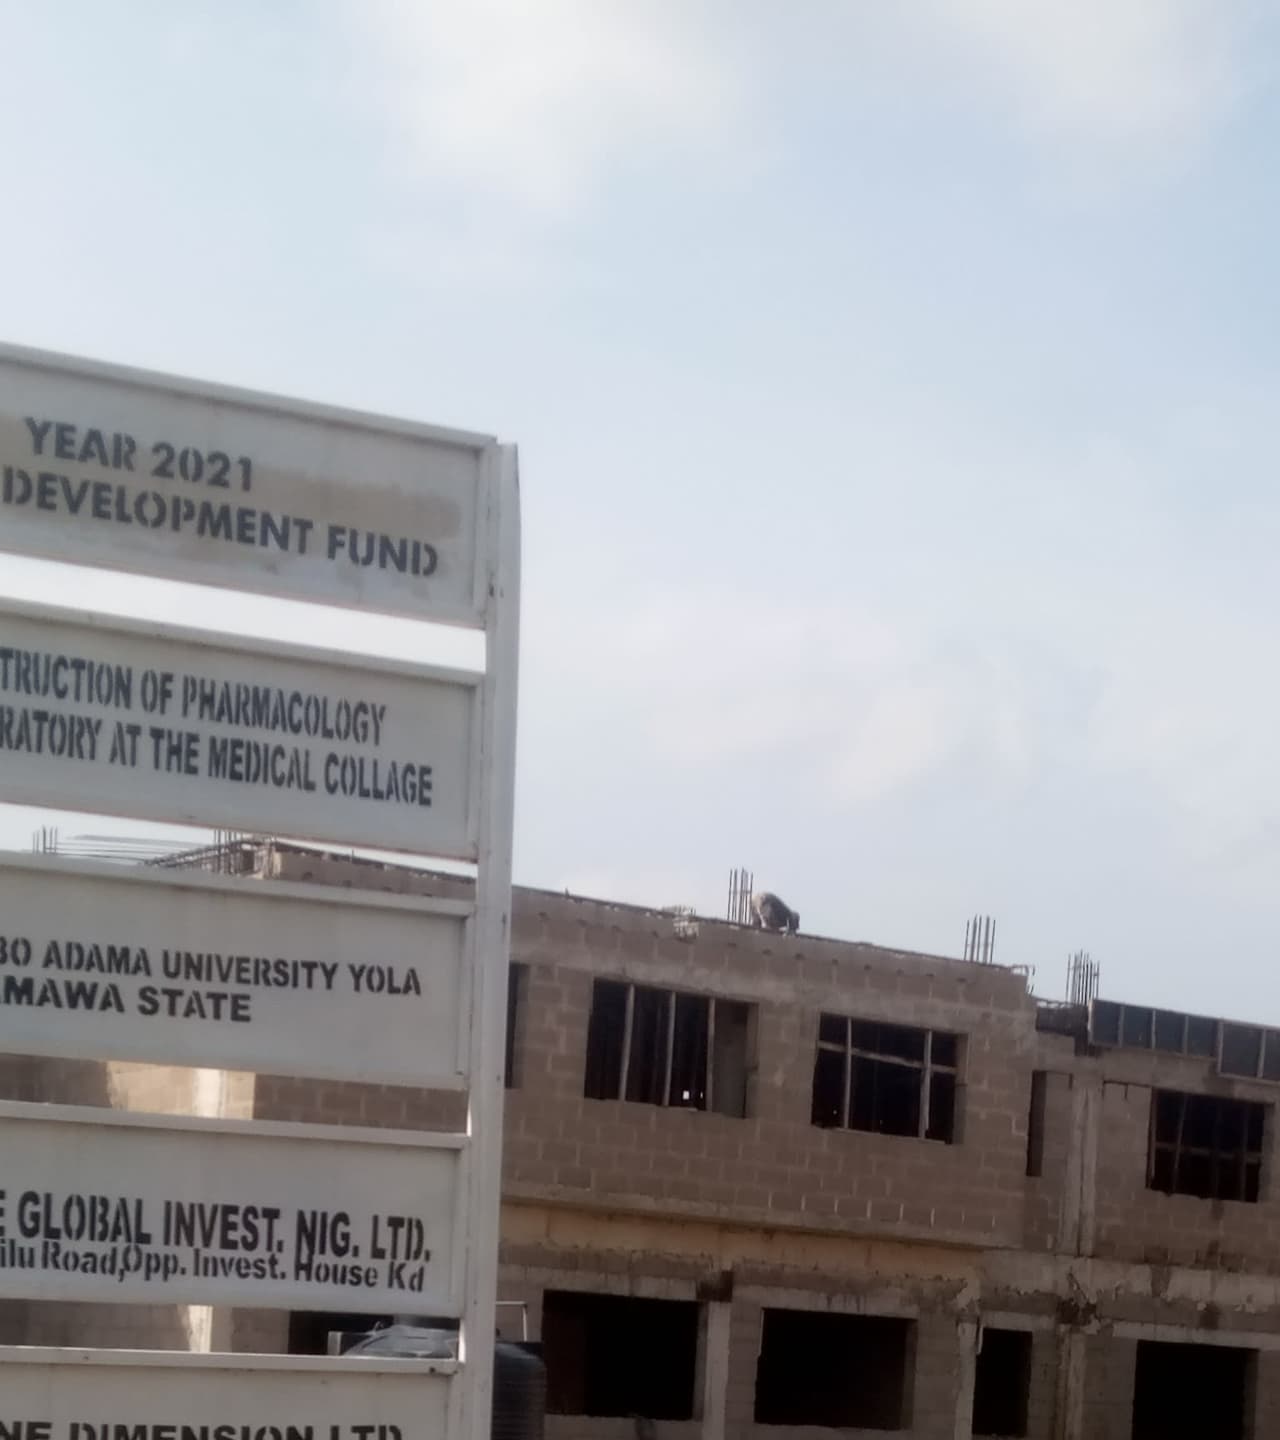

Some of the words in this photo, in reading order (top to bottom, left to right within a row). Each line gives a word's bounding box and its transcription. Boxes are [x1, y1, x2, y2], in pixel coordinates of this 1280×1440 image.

[25, 416, 136, 473] YEAR
[151, 442, 254, 492] 2021
[3, 465, 314, 557] DEVELOPMENT
[328, 525, 439, 578] FUND
[141, 671, 173, 711] OF
[182, 676, 386, 746] PHARMACOLOGY
[109, 722, 145, 768] AT
[149, 725, 200, 777] THE
[208, 733, 317, 793] MEDICAL
[324, 755, 433, 807] COLLAGE
[42, 944, 151, 978] ADAMA
[162, 951, 338, 991] UNIVERSITY
[347, 963, 423, 997] YOLA
[137, 986, 253, 1024] STATE
[17, 1190, 152, 1245] GLOBAL
[163, 1200, 284, 1253] INVEST.
[296, 1209, 359, 1258] NIG.
[370, 1214, 431, 1263] LTD.
[193, 1248, 287, 1281] Invest.
[294, 1252, 379, 1289] House
[387, 1261, 425, 1293] Kd
